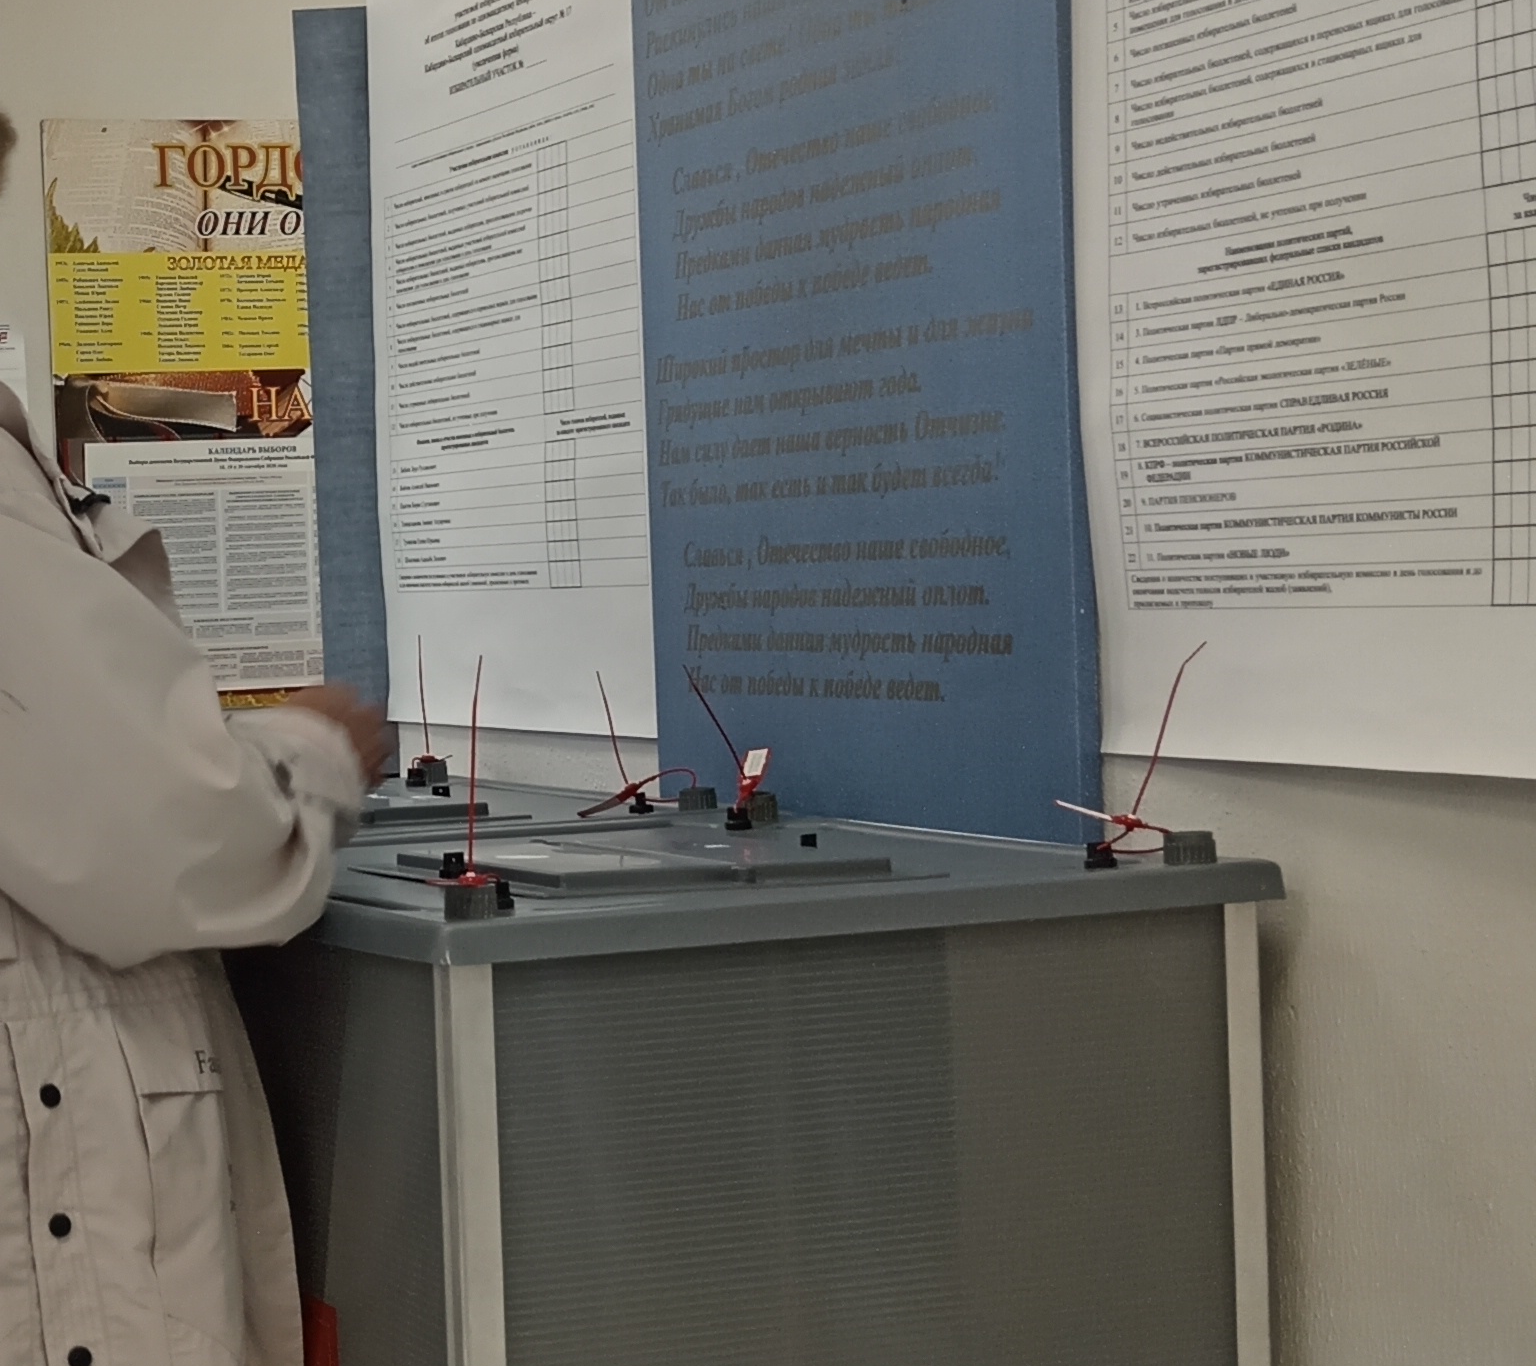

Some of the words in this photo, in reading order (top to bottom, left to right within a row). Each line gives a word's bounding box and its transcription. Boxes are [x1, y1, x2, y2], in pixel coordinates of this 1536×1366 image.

[197, 210, 271, 236] ОНИ
[279, 210, 305, 236] О
[167, 255, 253, 271] ЗОЛОТАЯ
[208, 446, 257, 455] КАЛЕНДАРЬ
[258, 445, 297, 454] ВЫБОРОВ
[756, 534, 852, 565] Отечество
[827, 629, 916, 661] мудрость
[920, 629, 1014, 662] народная
[746, 670, 804, 696] победы
[822, 675, 882, 699] победе
[885, 673, 946, 702] ведет.
